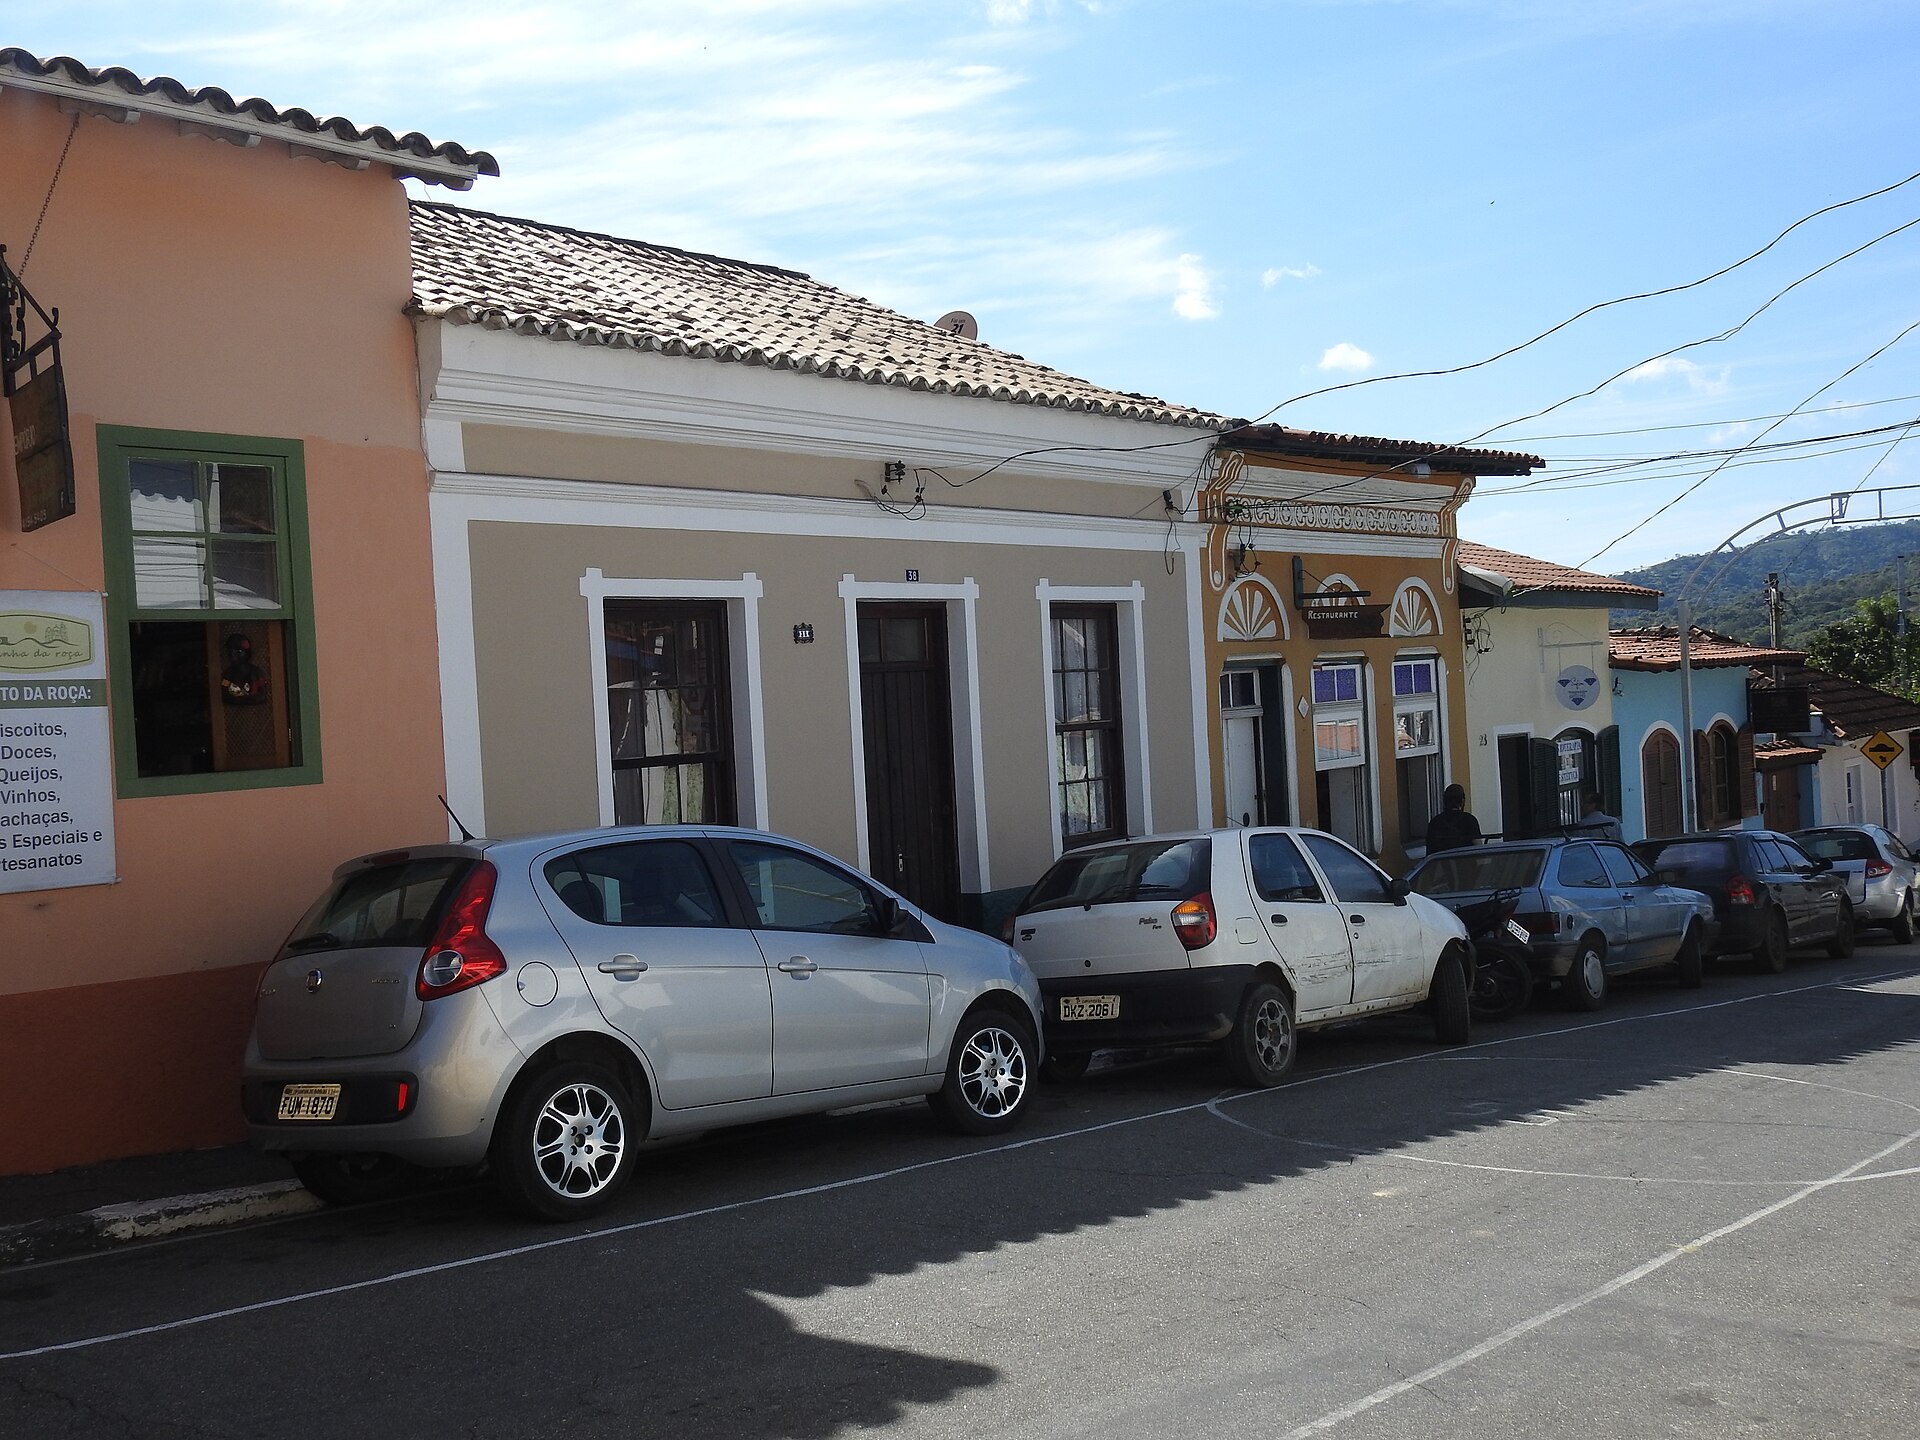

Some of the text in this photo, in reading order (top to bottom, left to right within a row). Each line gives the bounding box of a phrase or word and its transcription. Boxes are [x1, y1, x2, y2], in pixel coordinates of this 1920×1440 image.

[951, 323, 965, 334] 21
[908, 570, 917, 581] 38
[0, 648, 83, 660] nha da roça
[0, 685, 92, 704] TO DA ROÇA:
[0, 722, 67, 738] iscoitos,
[1, 745, 57, 760] Doces,
[0, 766, 62, 785] Queijos,
[0, 789, 60, 804] Vinhos,
[0, 811, 73, 828] achaças,
[12, 829, 89, 850] Especiais
[93, 830, 103, 842] e
[0, 853, 83, 872] tesanatos
